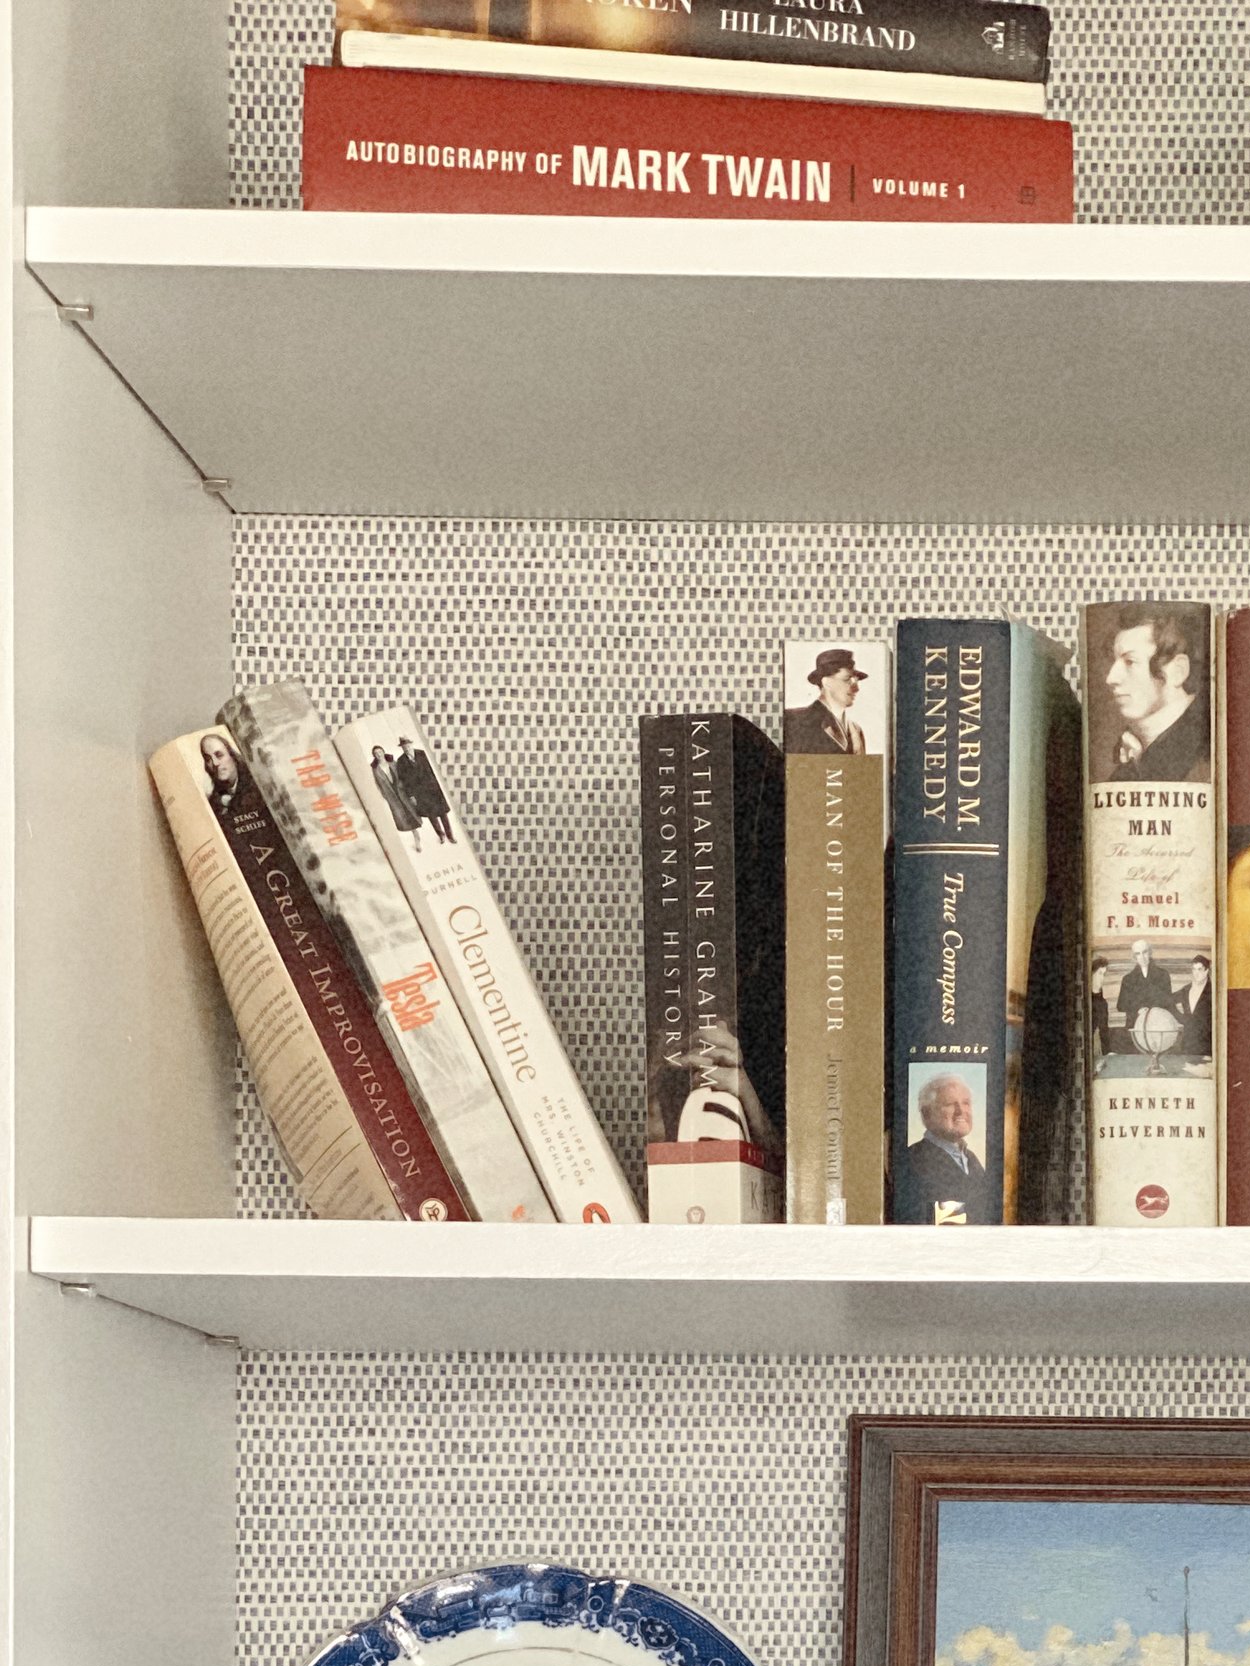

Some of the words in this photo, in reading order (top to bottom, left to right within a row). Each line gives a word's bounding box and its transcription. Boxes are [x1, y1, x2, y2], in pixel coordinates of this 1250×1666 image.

[720, 9, 916, 52] HILLENBRAND
[346, 140, 527, 174] AUTOBIOGRAPHY
[536, 153, 562, 175] OF
[573, 145, 691, 194] MARK
[701, 153, 831, 203] TWAIN
[872, 178, 949, 198] VOLUME
[957, 184, 966, 199] 1
[923, 646, 948, 823] KENNEDY
[957, 646, 983, 788] EDWARD
[233, 810, 260, 824] STACY
[235, 819, 267, 835] SCHIFF
[658, 747, 679, 907] PERSONAL
[691, 720, 715, 918] KATHARINE
[826, 769, 843, 828] MAN
[957, 796, 981, 831] M.
[1094, 791, 1208, 809] LIGHTNING
[1128, 819, 1173, 836] MAN
[426, 864, 464, 882] SONIA
[826, 840, 843, 875] OF
[826, 886, 844, 941] THE
[943, 872, 964, 923] True
[1107, 916, 1119, 929] F.
[1126, 916, 1141, 929] B.
[1148, 916, 1195, 929] Morse
[1121, 891, 1180, 905] Samuel
[448, 904, 537, 1084] Clementine
[663, 931, 682, 1067] HISTORY
[826, 955, 844, 1032] HOUR
[936, 930, 964, 1025] Compass
[250, 842, 274, 865] A
[266, 869, 319, 960] GREAT
[309, 963, 421, 1179] IMPROVISATION
[696, 941, 719, 1088] GRAHAM
[826, 1053, 843, 1114] Jennet
[1109, 1097, 1196, 1110] KENNETH
[533, 1112, 567, 1181] CHURCHILL
[826, 1117, 843, 1181] Conant
[1099, 1126, 1206, 1139] SILVERMAN
